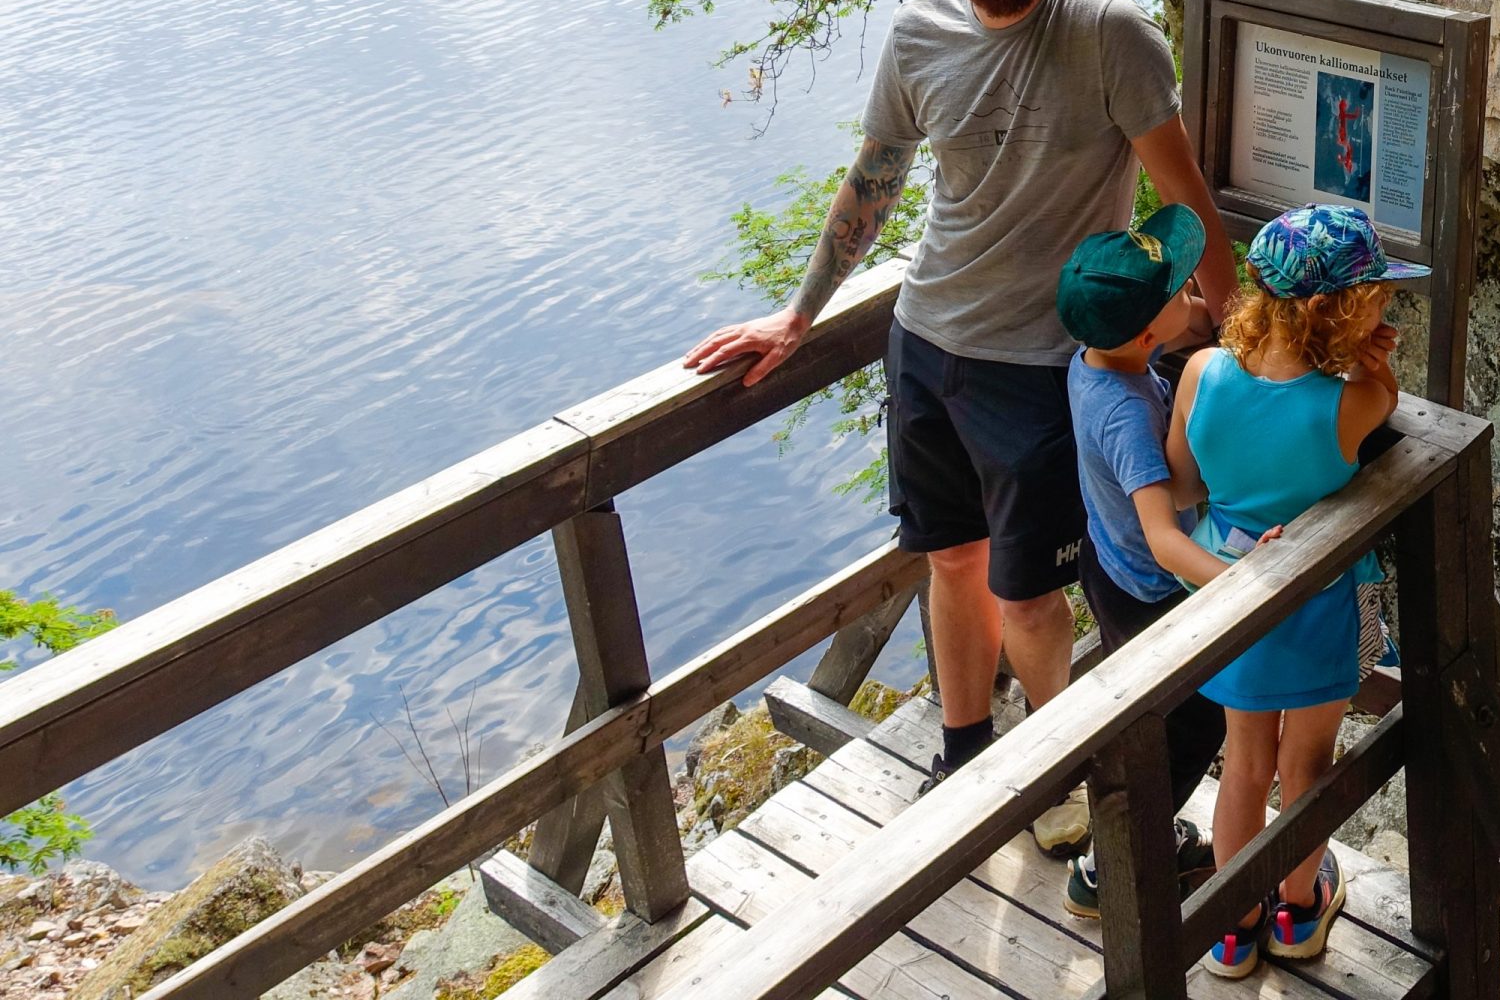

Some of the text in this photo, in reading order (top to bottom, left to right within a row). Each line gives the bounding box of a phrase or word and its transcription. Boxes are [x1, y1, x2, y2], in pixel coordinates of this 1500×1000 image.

[1256, 41, 1316, 63] Ukonvuoren
[1320, 54, 1408, 83] kalliomaalaukset
[1056, 538, 1083, 567] HH
